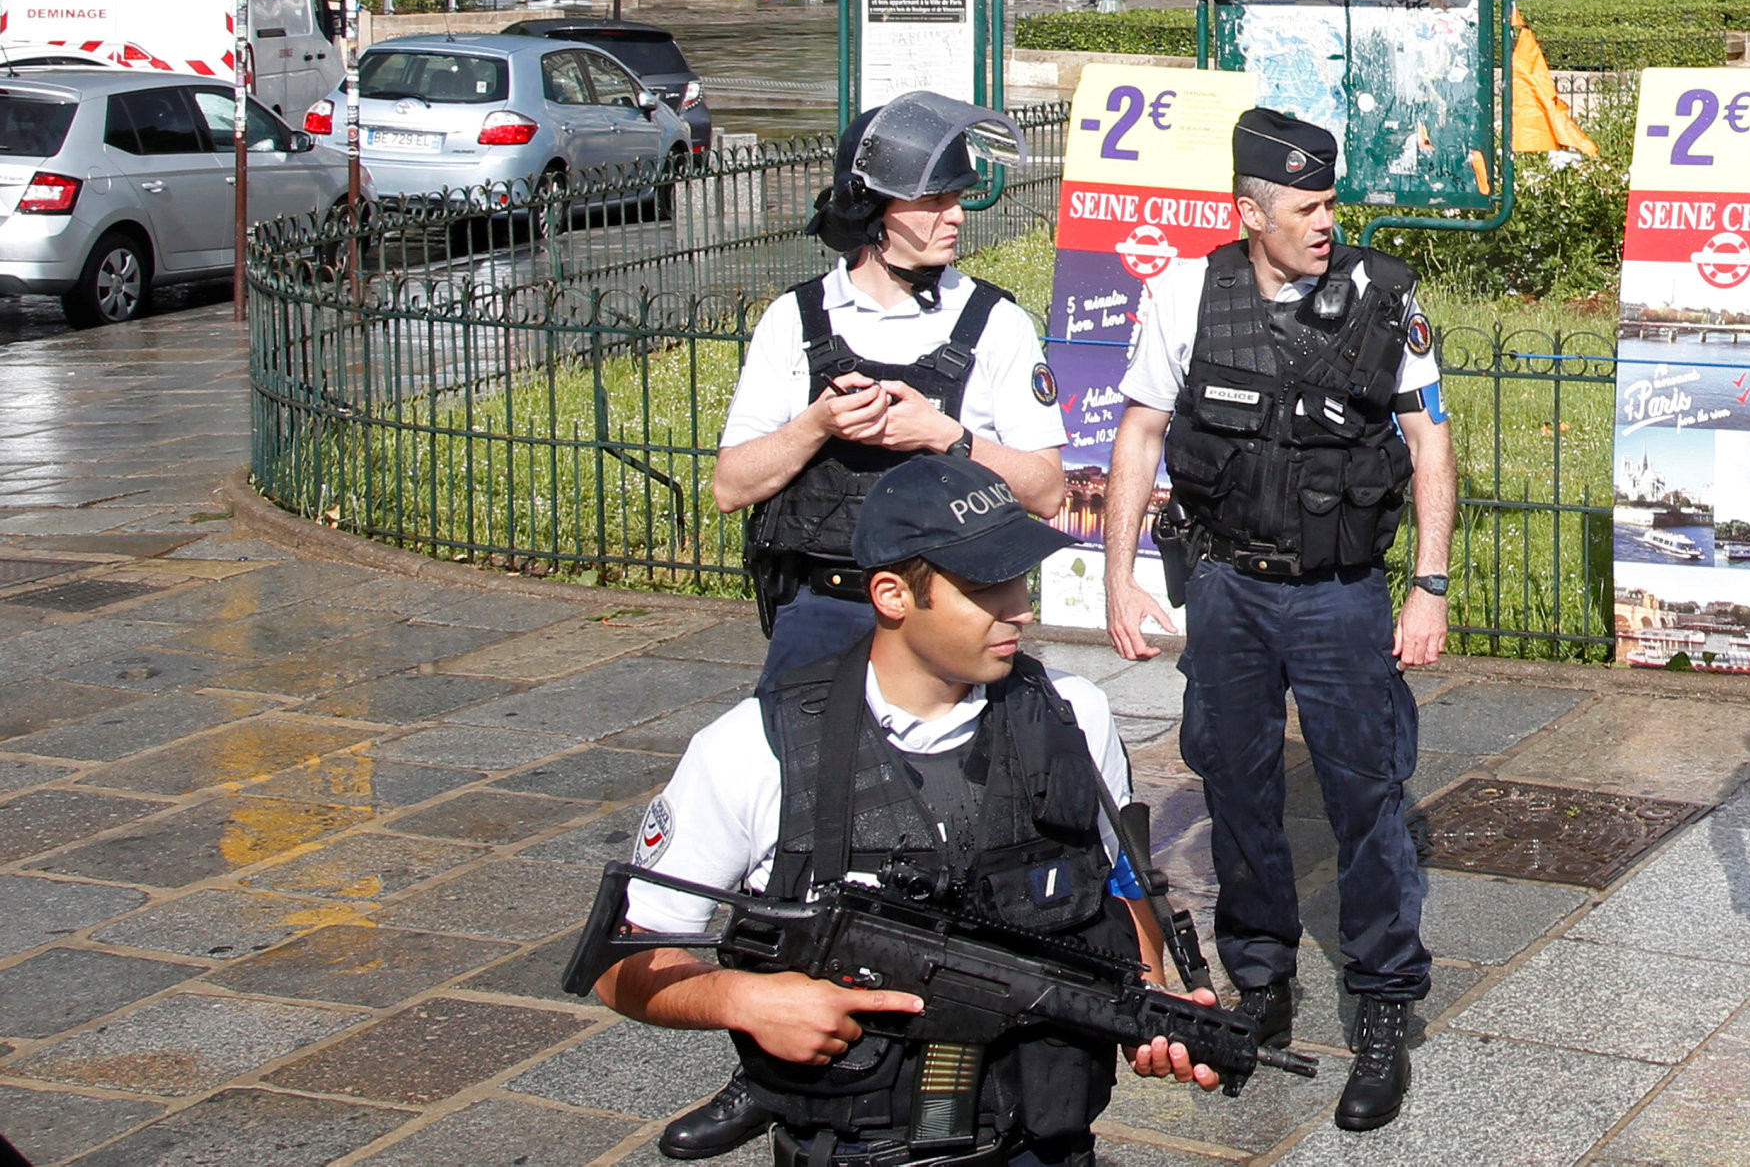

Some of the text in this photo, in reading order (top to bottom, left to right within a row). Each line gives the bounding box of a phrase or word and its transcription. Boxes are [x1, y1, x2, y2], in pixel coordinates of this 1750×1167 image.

[27, 8, 107, 19] DEMINAGE
[1069, 191, 1232, 230] SEINE CRUISE
[1638, 200, 1716, 230] SEINE
[1066, 289, 1129, 314] 5 minutes
[1066, 309, 1126, 342] from here
[1209, 390, 1256, 401] POLICE
[1624, 380, 1692, 421] Paris
